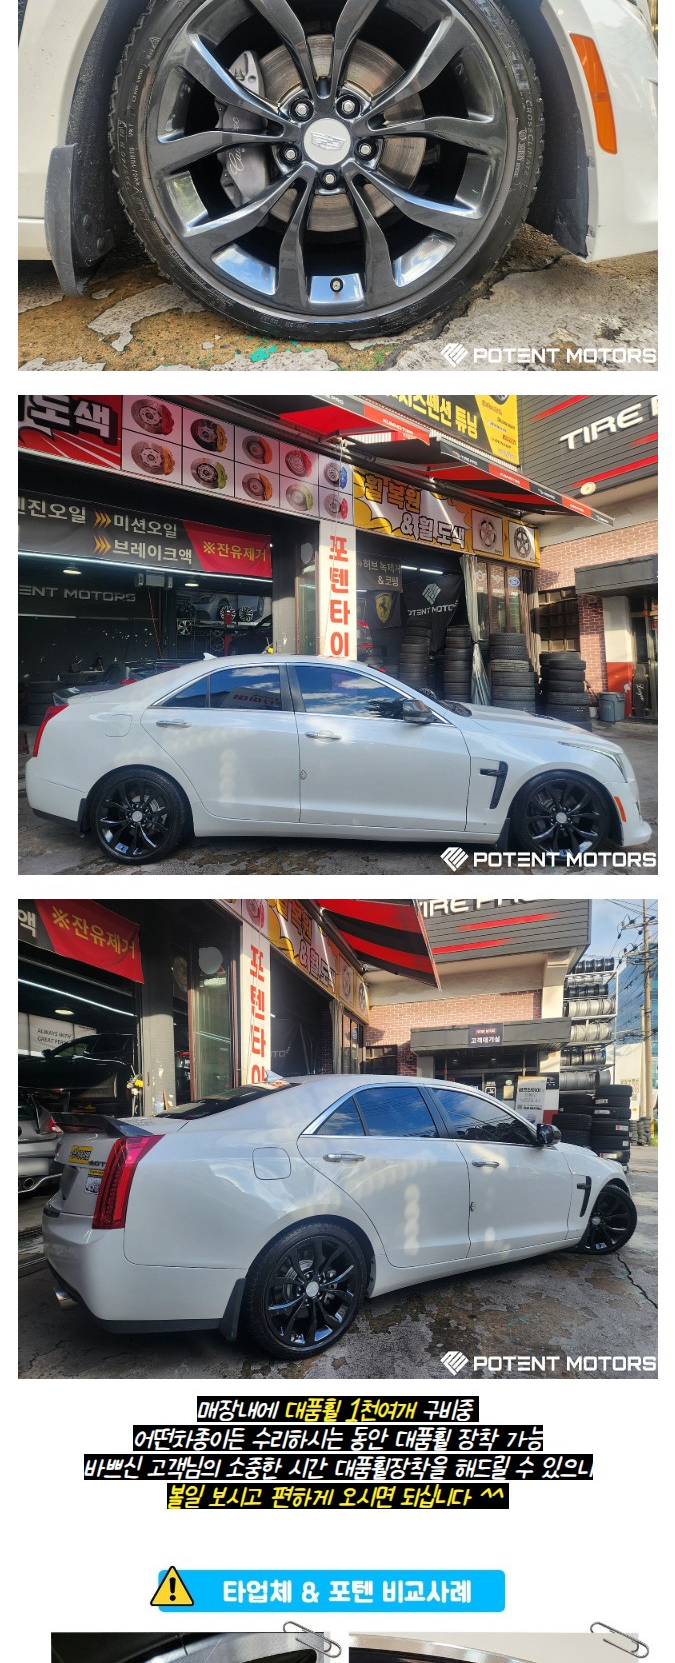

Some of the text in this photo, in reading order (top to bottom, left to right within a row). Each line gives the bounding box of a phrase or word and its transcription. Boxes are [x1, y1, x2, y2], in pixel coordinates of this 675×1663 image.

[27, 396, 110, 438] 도색
[455, 405, 477, 439] 튜닝
[560, 402, 644, 449] TIRE
[113, 513, 177, 538] 미션오일
[112, 540, 192, 563] 브레이크액
